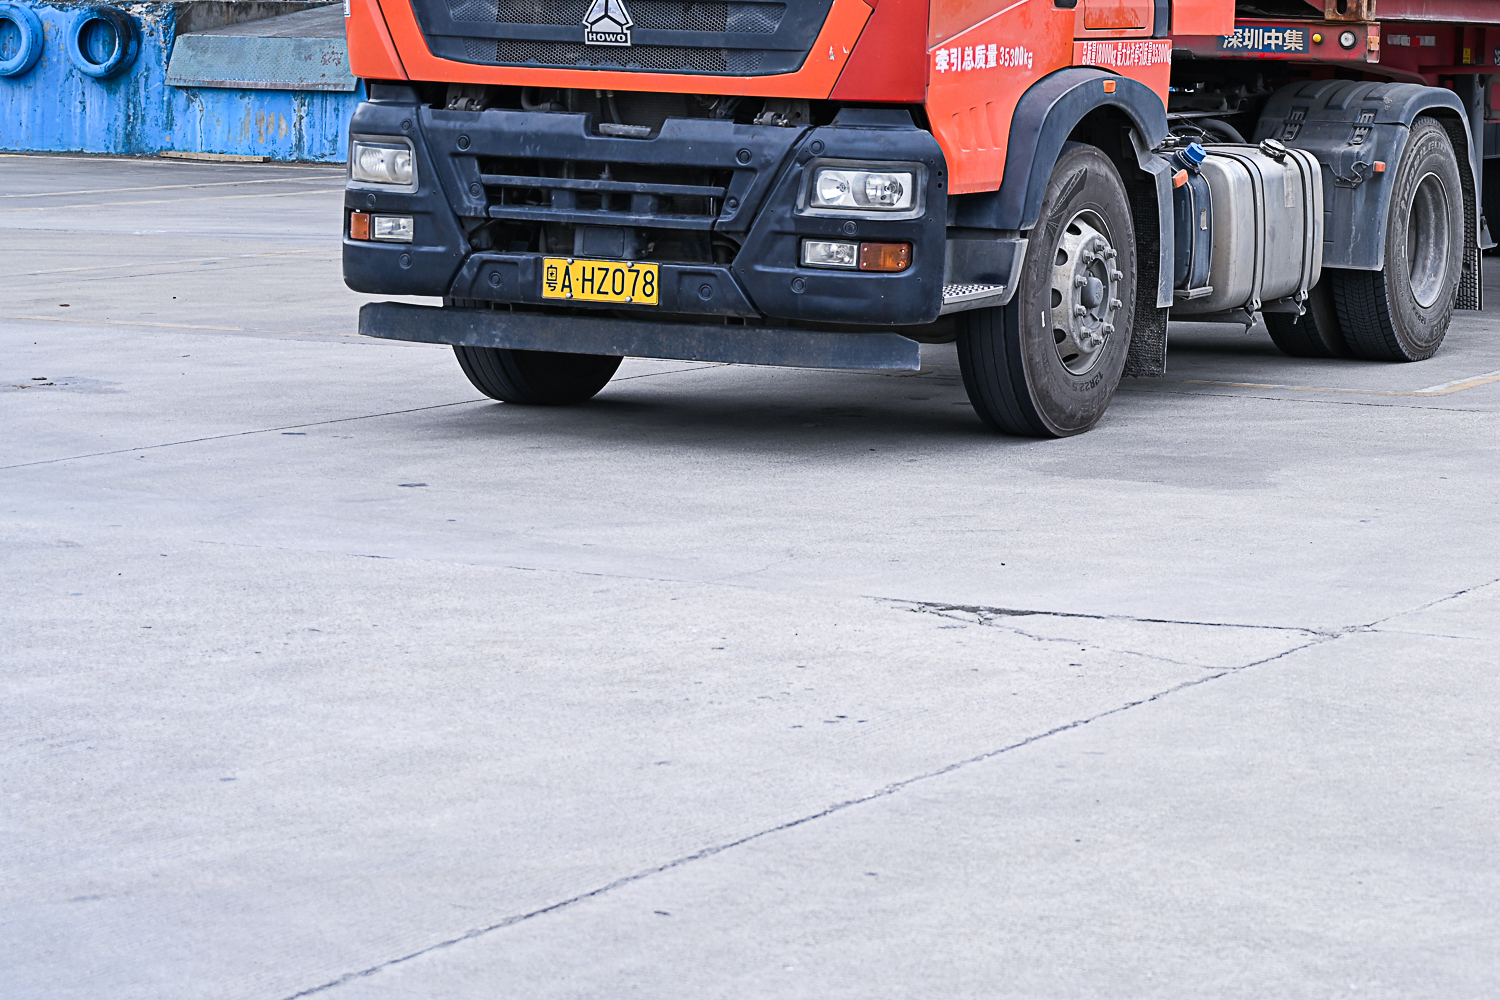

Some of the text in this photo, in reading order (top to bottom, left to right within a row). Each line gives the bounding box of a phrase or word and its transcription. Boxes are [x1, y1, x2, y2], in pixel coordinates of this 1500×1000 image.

[587, 32, 628, 43] HOWO
[1223, 27, 1305, 51] 深圳中集
[935, 44, 998, 74] 牵引总质量
